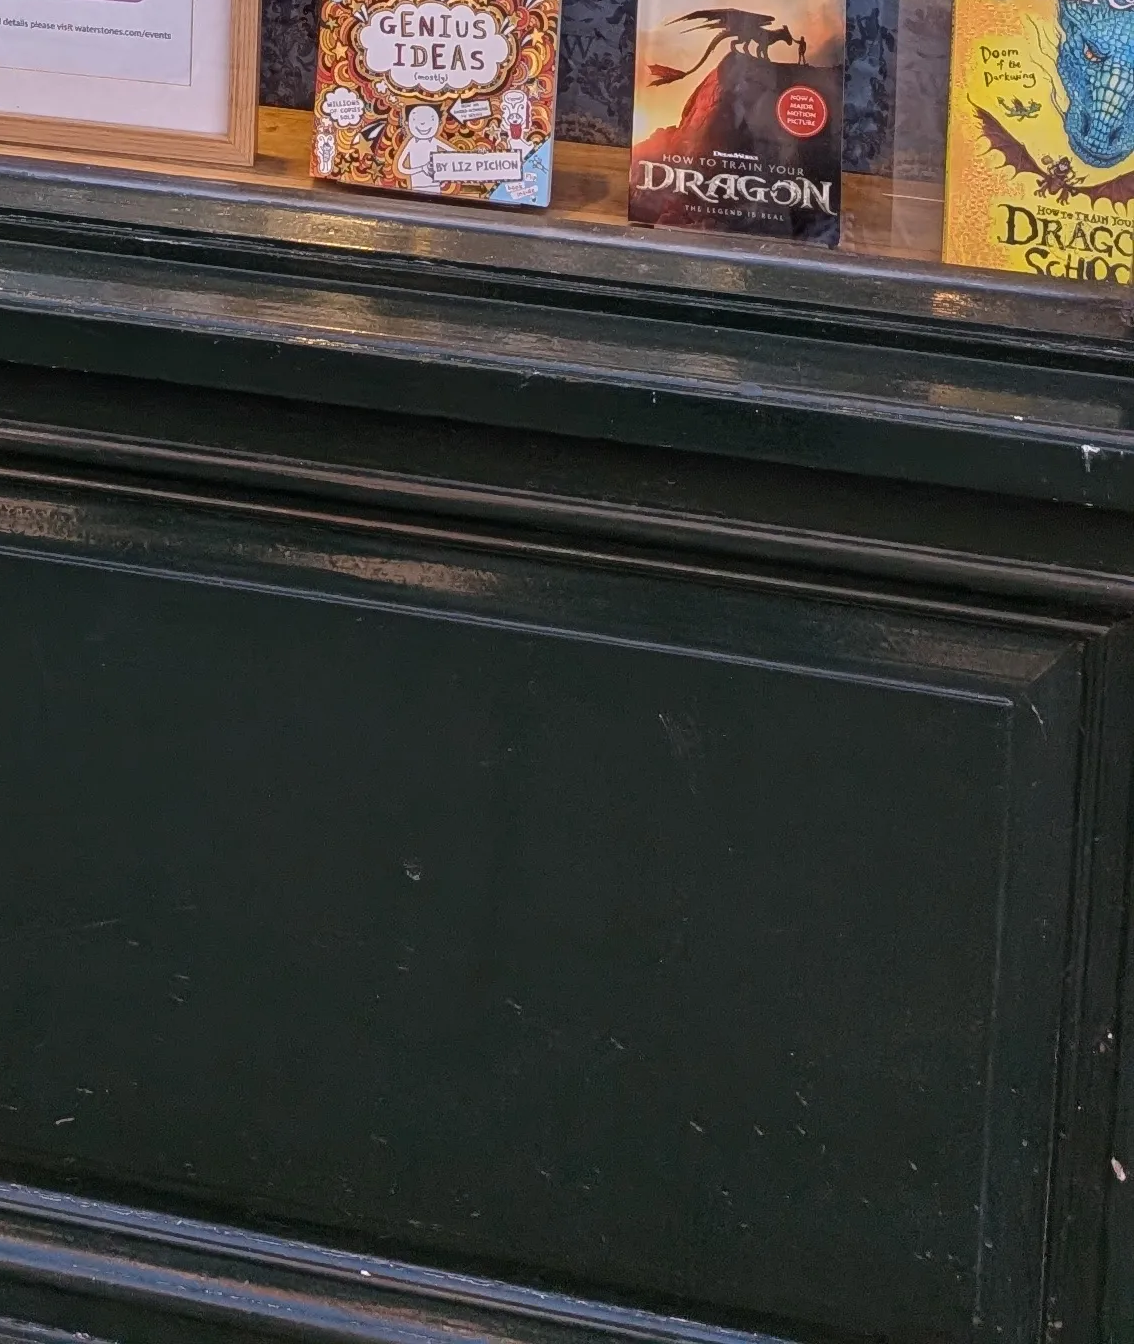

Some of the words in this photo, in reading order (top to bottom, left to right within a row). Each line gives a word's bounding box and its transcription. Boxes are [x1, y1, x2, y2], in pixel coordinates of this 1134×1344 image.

[2, 18, 28, 27] details
[30, 21, 55, 29] please
[75, 25, 170, 39] waterstones.com/events
[380, 13, 486, 39] GENIUS
[393, 43, 484, 70] IDEAS
[979, 46, 1018, 64] Doom
[435, 162, 448, 172] BY
[452, 161, 471, 172] LIZ
[476, 160, 519, 171] PICHON
[662, 153, 694, 166] HOW
[699, 157, 716, 166] TO
[722, 160, 761, 171] TRAIN
[768, 165, 803, 175] YOUR
[636, 158, 837, 215] DRAGON
